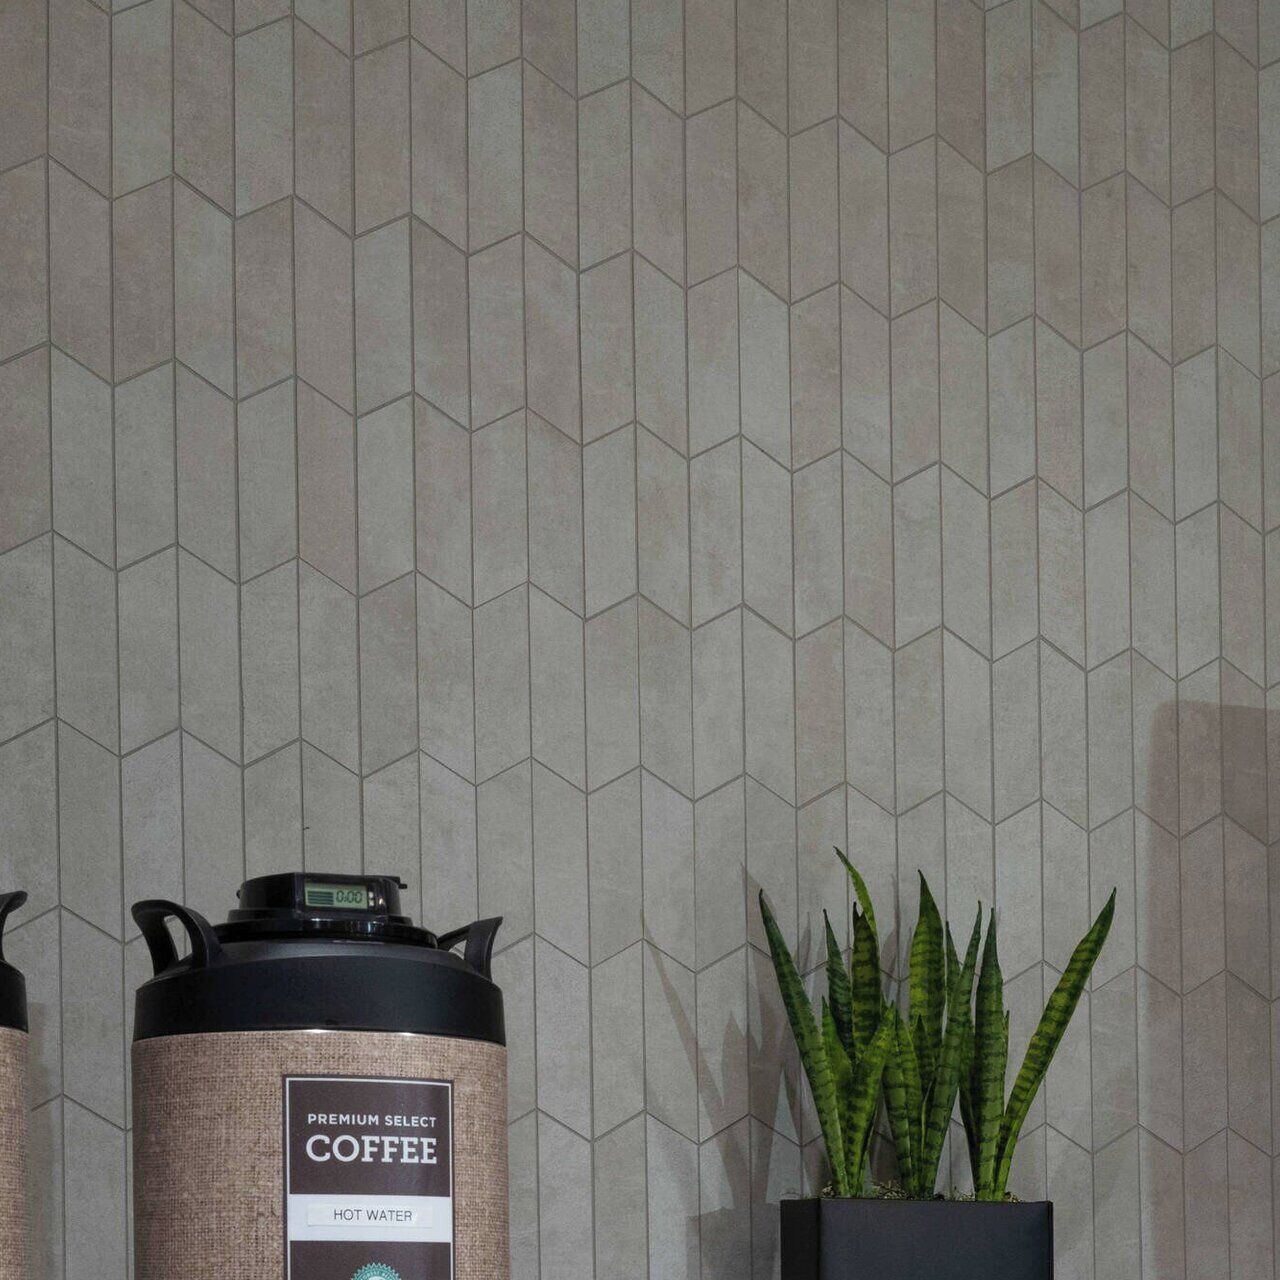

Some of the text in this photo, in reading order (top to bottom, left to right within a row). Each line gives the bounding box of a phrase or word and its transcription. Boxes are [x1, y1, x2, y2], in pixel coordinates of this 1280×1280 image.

[307, 1113, 437, 1128] PREMIUM SELECT
[306, 1134, 437, 1164] COFFEE
[333, 1208, 413, 1222] HOT WATER
